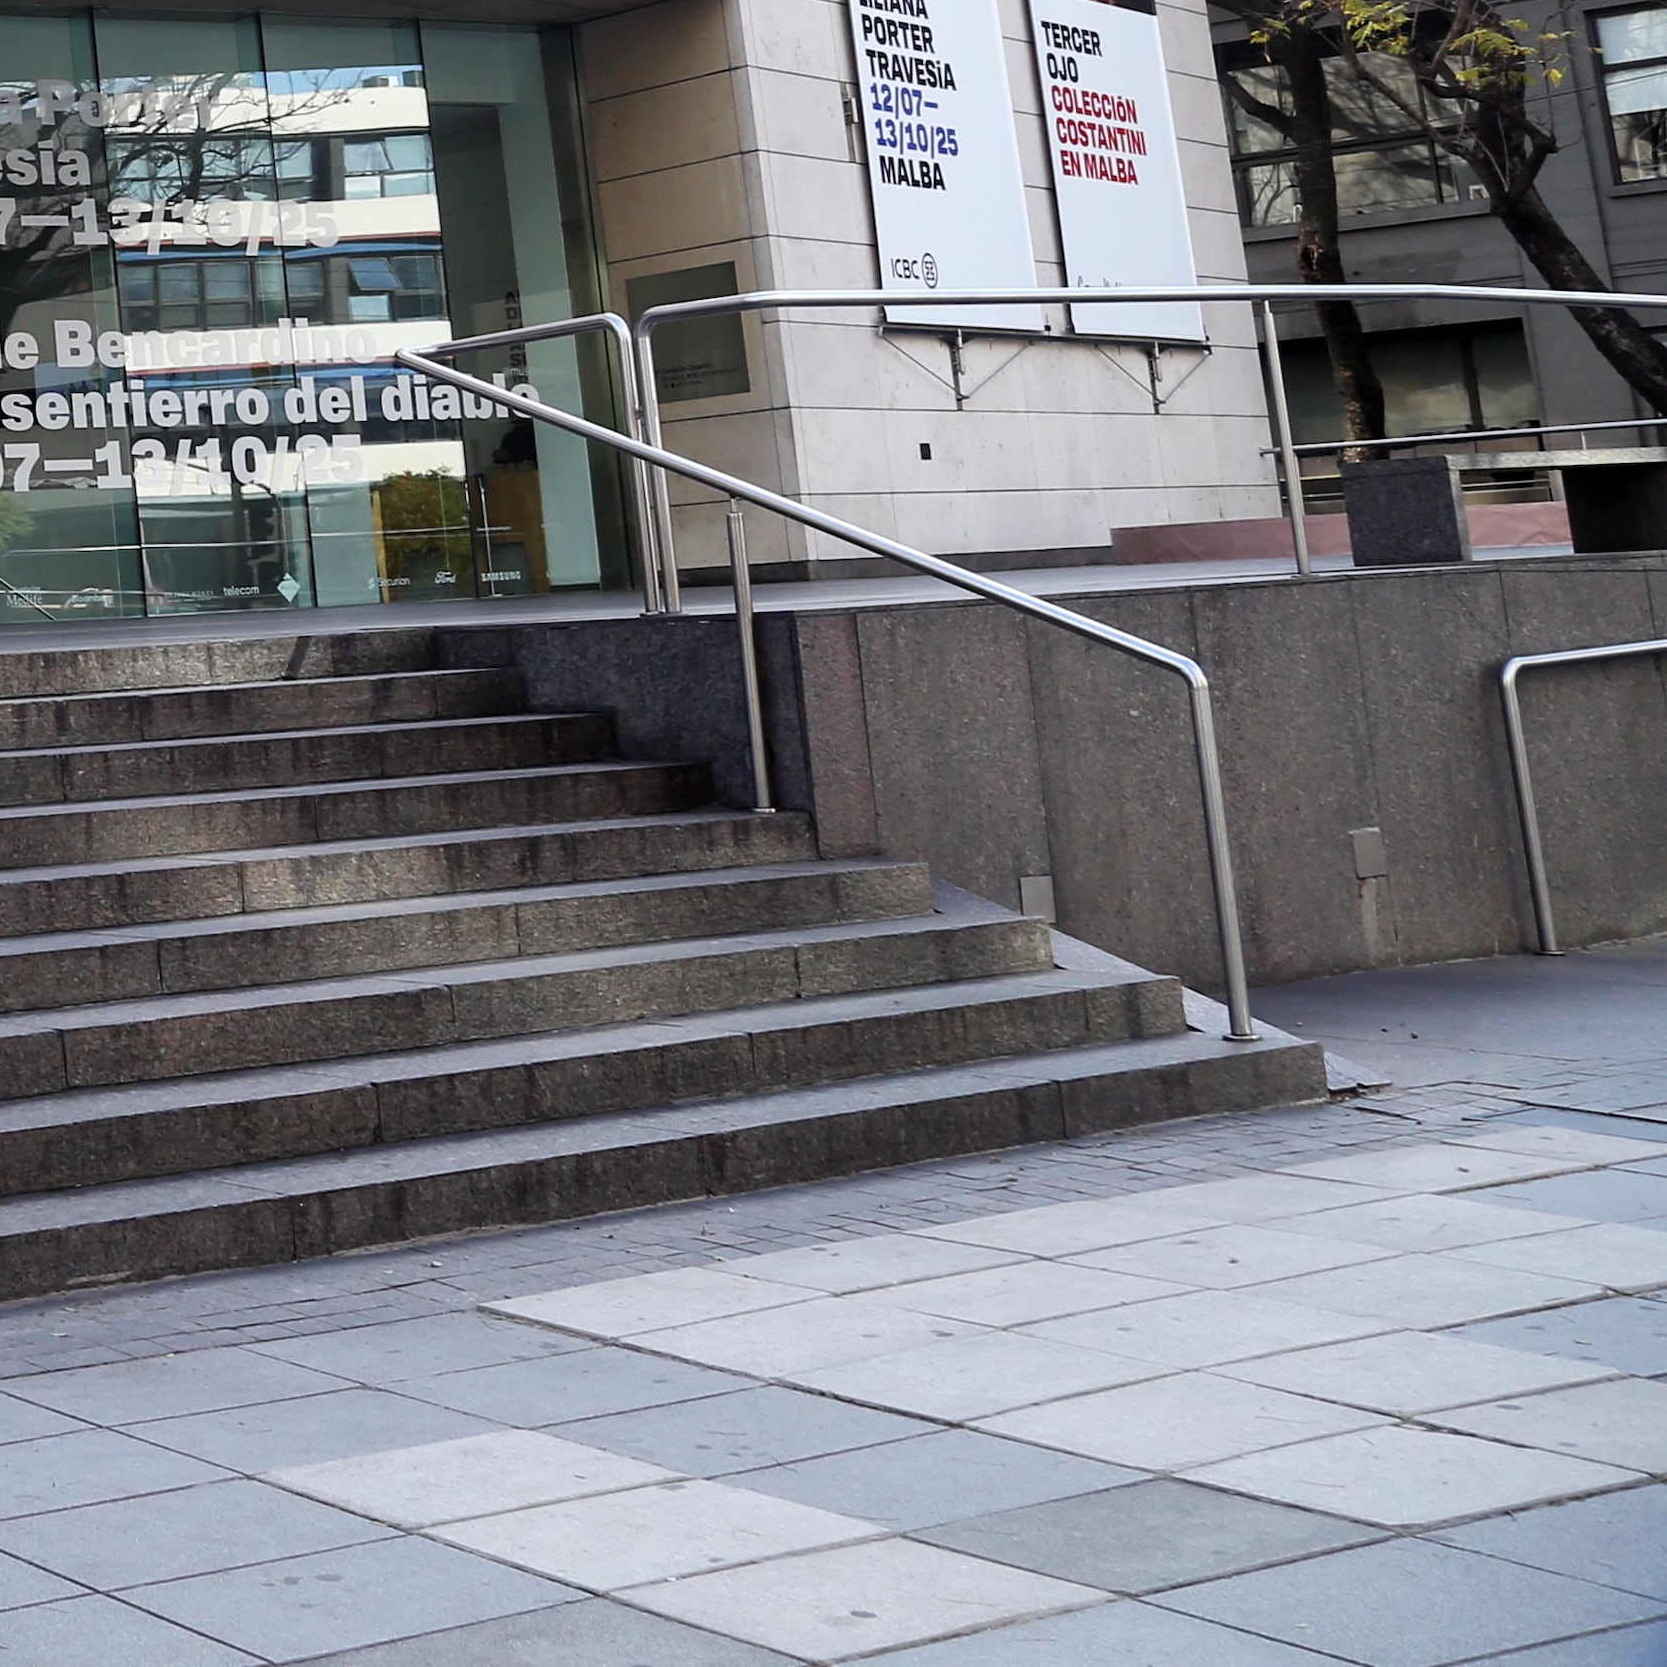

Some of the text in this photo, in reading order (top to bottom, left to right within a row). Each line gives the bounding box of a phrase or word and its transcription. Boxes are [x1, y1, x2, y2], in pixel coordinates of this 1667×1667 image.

[861, 13, 935, 54] PORTER
[1040, 20, 1103, 57] TERCER
[1046, 52, 1079, 83] OJO
[875, 118, 959, 160] 13/10/25
[1056, 117, 1147, 156] COSTANTINI
[879, 155, 947, 192] MALBA
[1060, 149, 1139, 185] EN MALBA
[890, 258, 920, 280] ICBC
[53, 317, 378, 369] Bencardino
[284, 375, 367, 426] del
[223, 585, 260, 596] telecom
[481, 570, 522, 582] SAMSUNG
